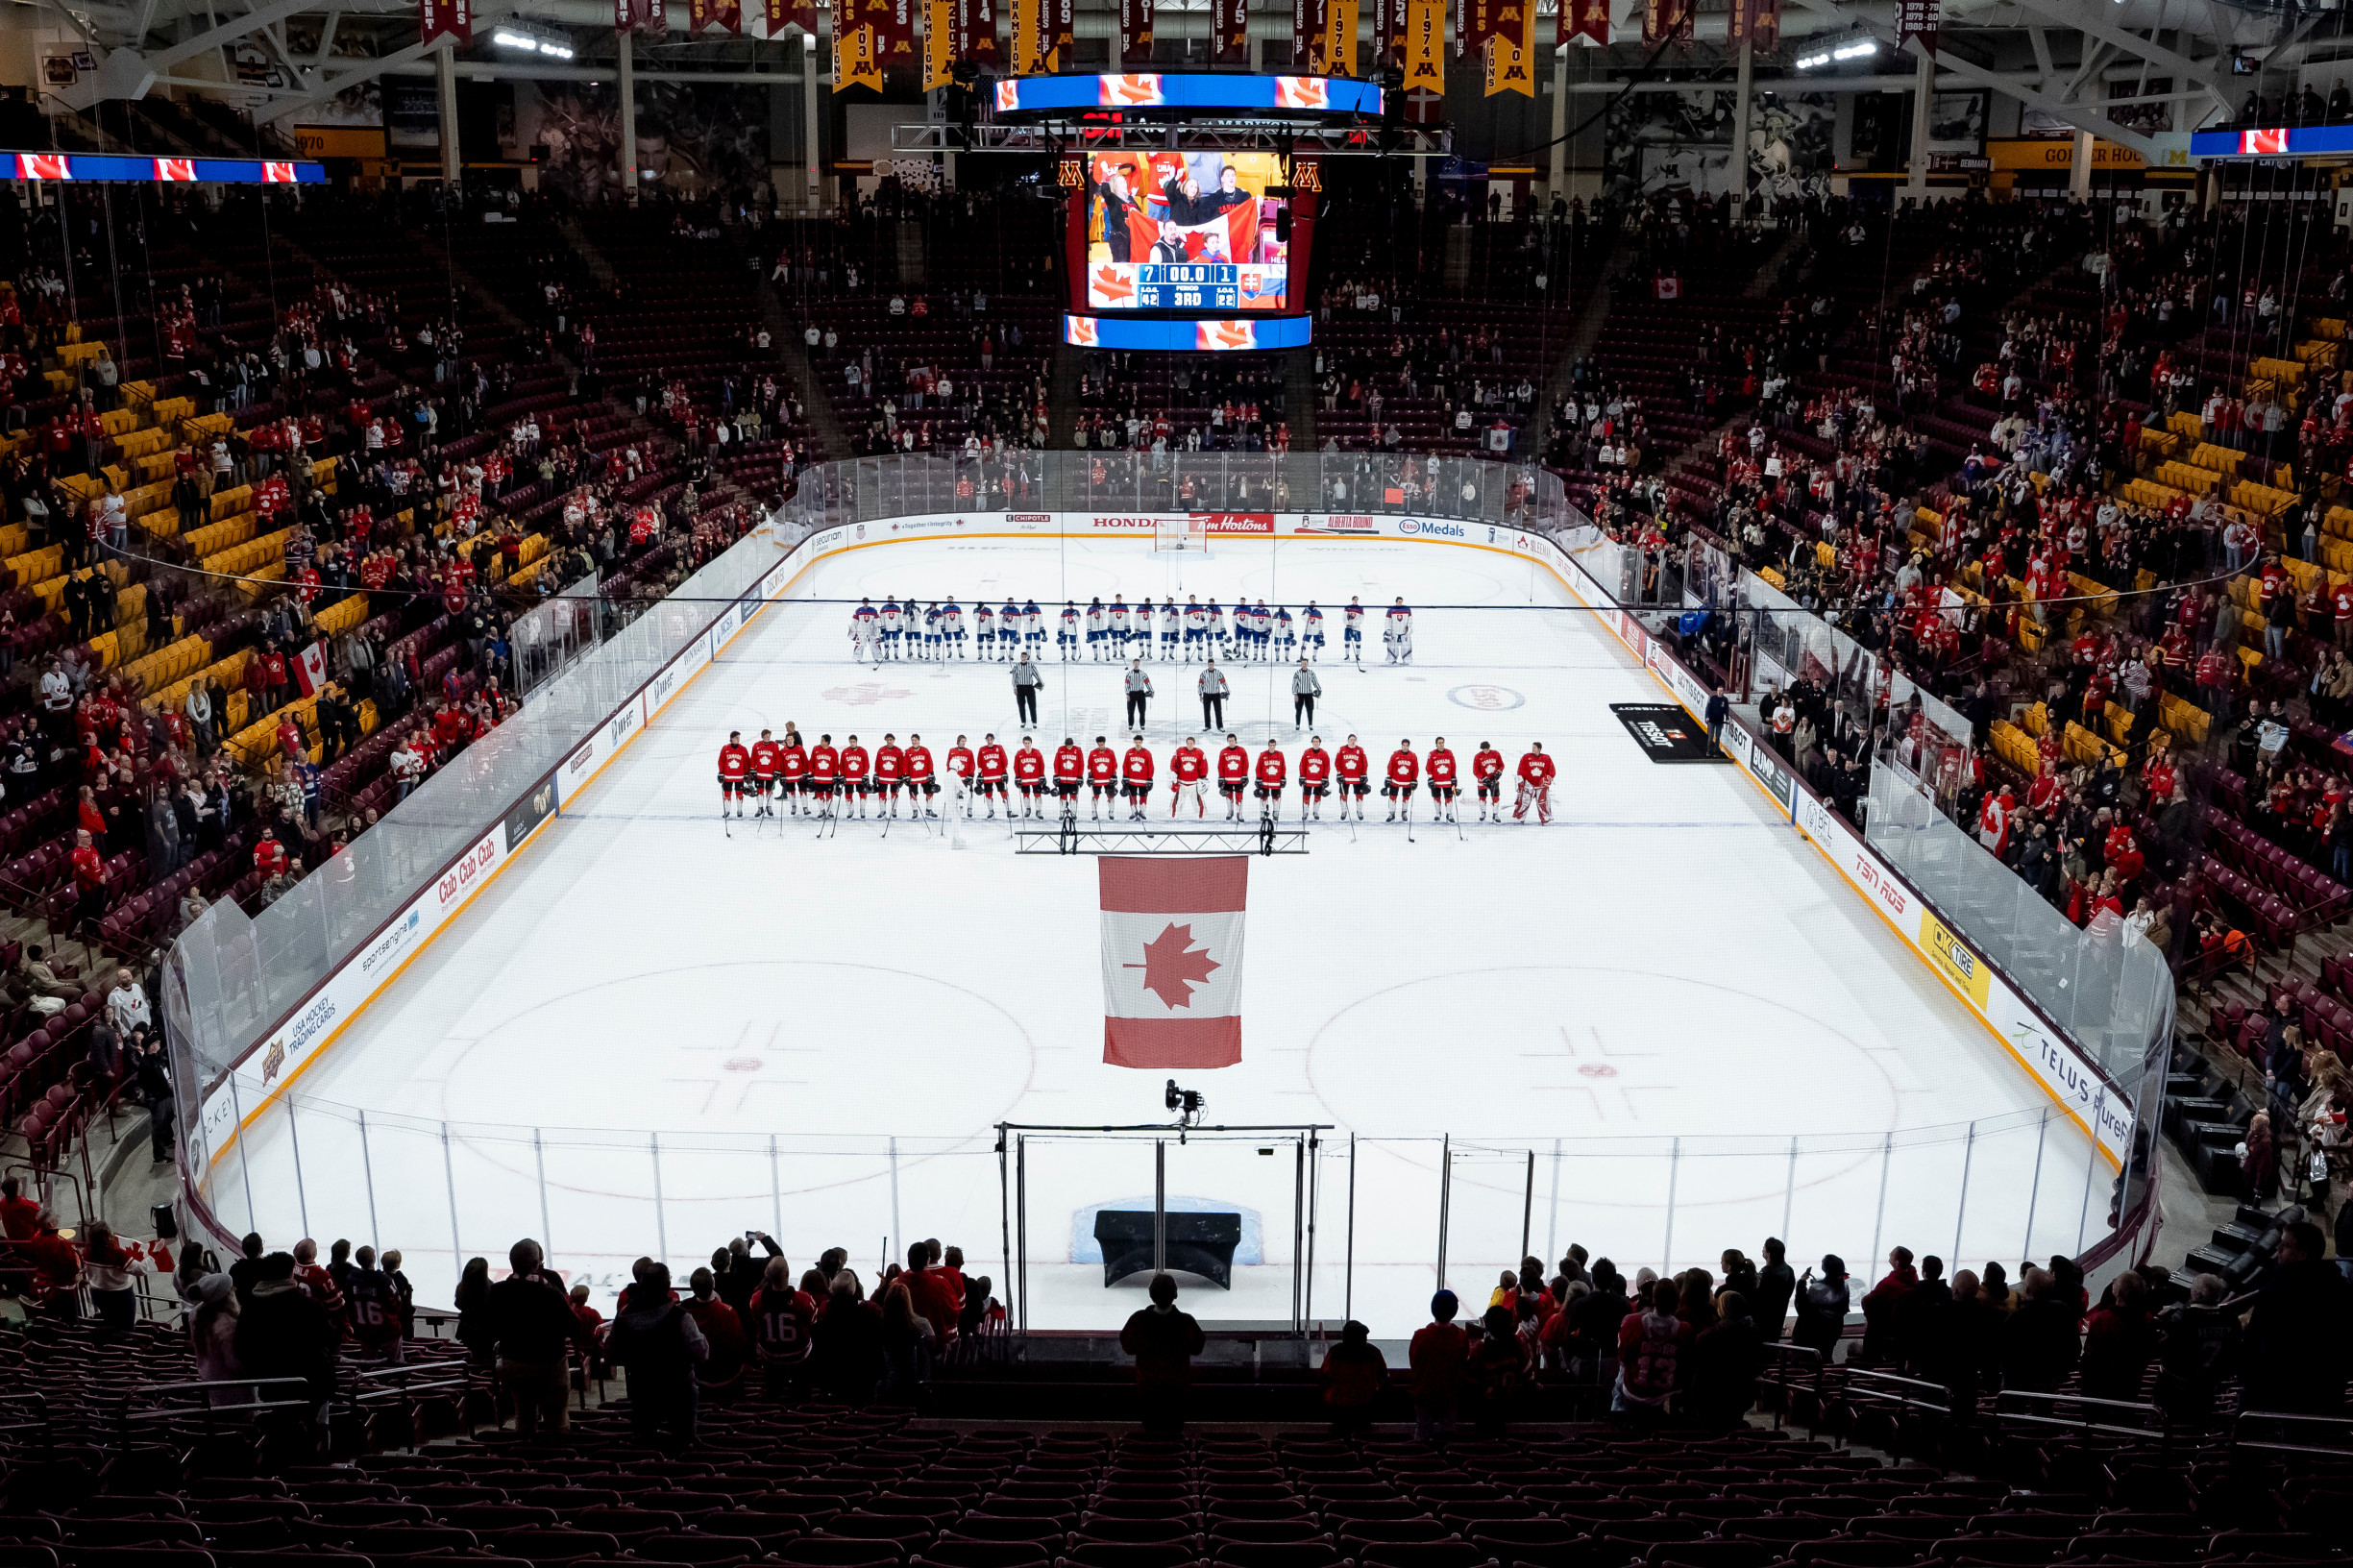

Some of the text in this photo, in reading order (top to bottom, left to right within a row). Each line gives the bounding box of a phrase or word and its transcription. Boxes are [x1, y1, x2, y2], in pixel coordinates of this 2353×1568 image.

[923, 0, 932, 84] HAMPIONS
[1335, 8, 1344, 58] 1976
[1421, 8, 1432, 58] 1974
[1144, 267, 1154, 282] 7
[1169, 267, 1205, 282] 00.0
[1220, 267, 1231, 282] 1
[1174, 293, 1202, 306] 3RD
[1093, 518, 1165, 527] HONDA
[1219, 516, 1267, 530] Hortons
[1328, 516, 1352, 528] ALBERTA
[1353, 516, 1373, 528] BOUND
[1402, 522, 1464, 537] Esso Medals
[816, 530, 842, 547] securian
[1685, 678, 1704, 706] TISSOT
[1638, 721, 1674, 747] TISSOT
[1753, 745, 1775, 779] BUMP
[1818, 809, 1832, 840] BFL
[439, 873, 456, 904] Cub
[459, 855, 477, 885] Cub
[478, 838, 495, 867] Cub
[1856, 853, 1907, 914] TSN RDS
[362, 921, 408, 972] sportsengine
[1933, 922, 1973, 977] OK TIRE
[288, 1004, 336, 1055] TRADING CARDS
[292, 995, 330, 1038] USA HOCKEY
[2041, 1038, 2089, 1102] TELUS
[205, 1097, 232, 1139] CKEY
[354, 1300, 384, 1326] 16
[763, 1311, 797, 1343] 16
[1633, 1356, 1678, 1389] 13
